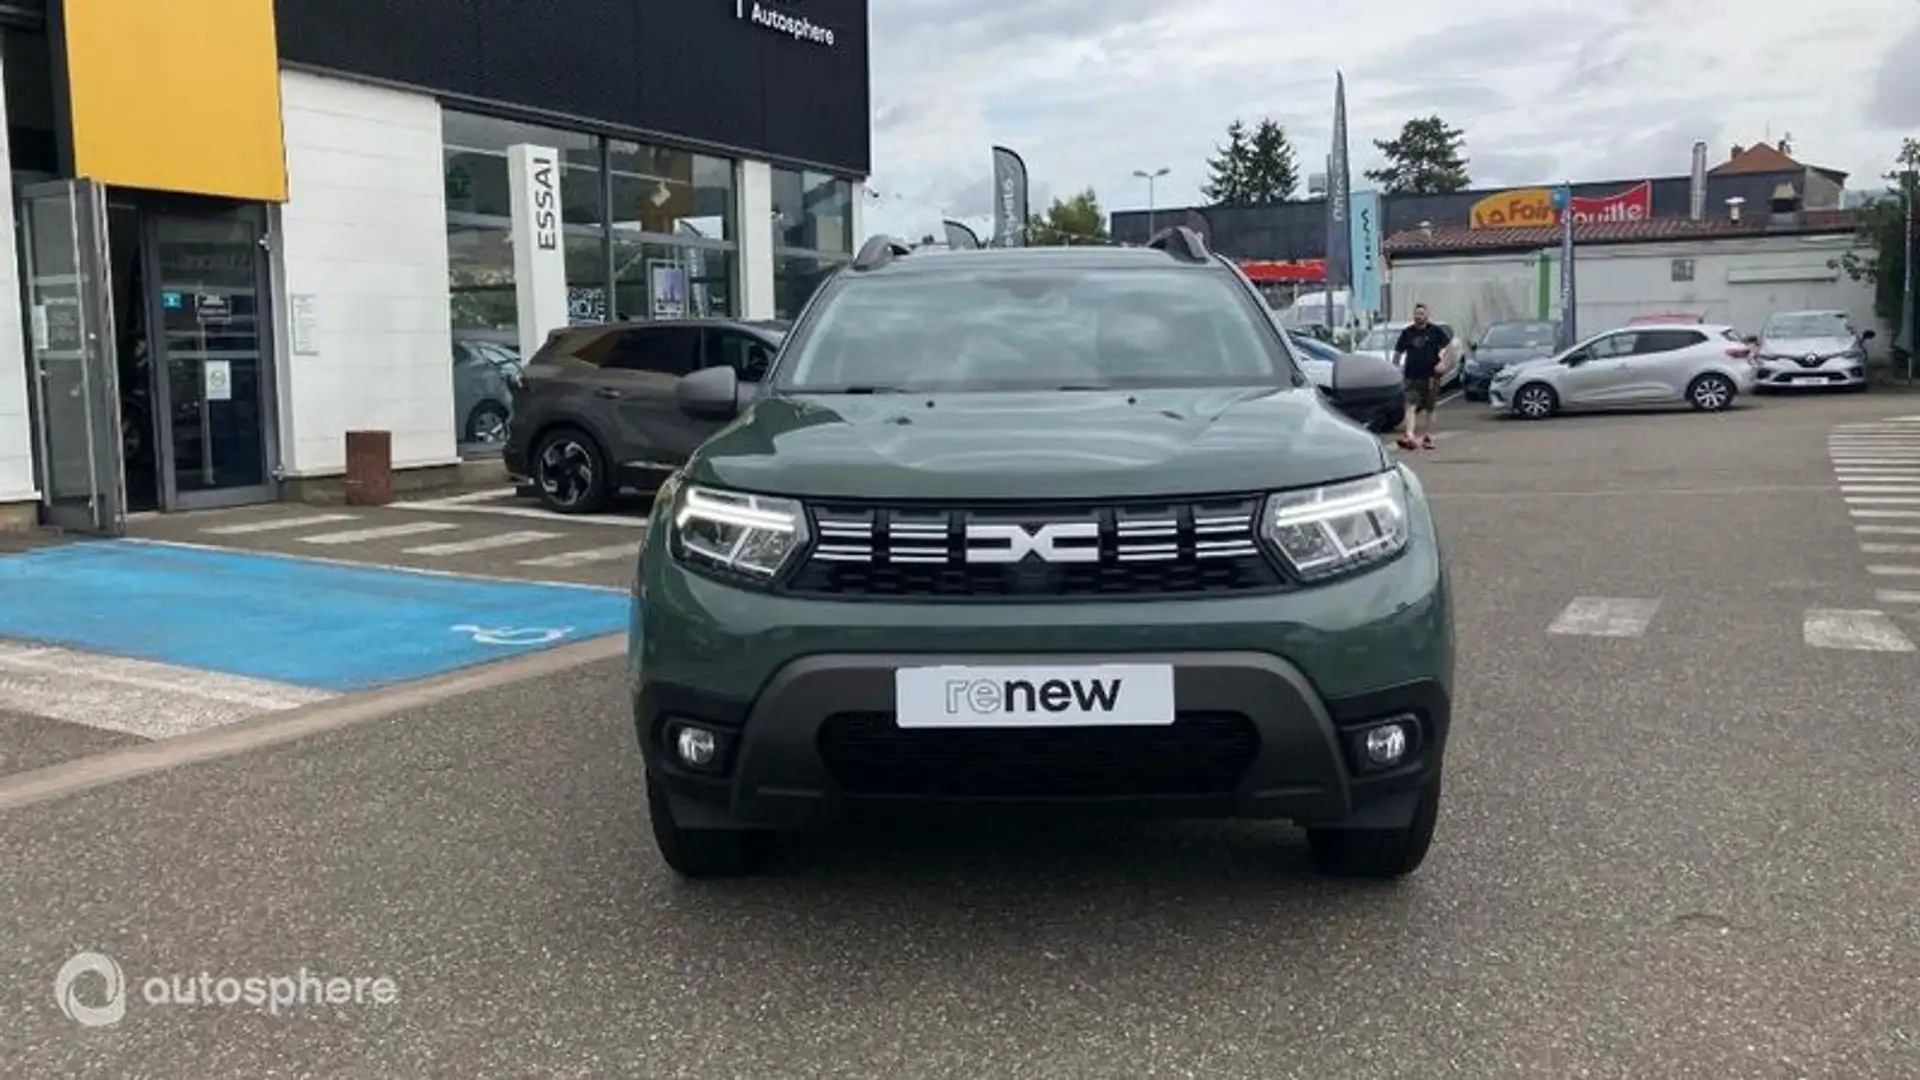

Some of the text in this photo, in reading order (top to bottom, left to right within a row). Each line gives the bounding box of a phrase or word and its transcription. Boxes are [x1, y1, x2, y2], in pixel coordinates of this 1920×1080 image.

[751, 2, 834, 46] Autosphere
[533, 157, 555, 250] ESSAI
[945, 678, 1121, 713] renew
